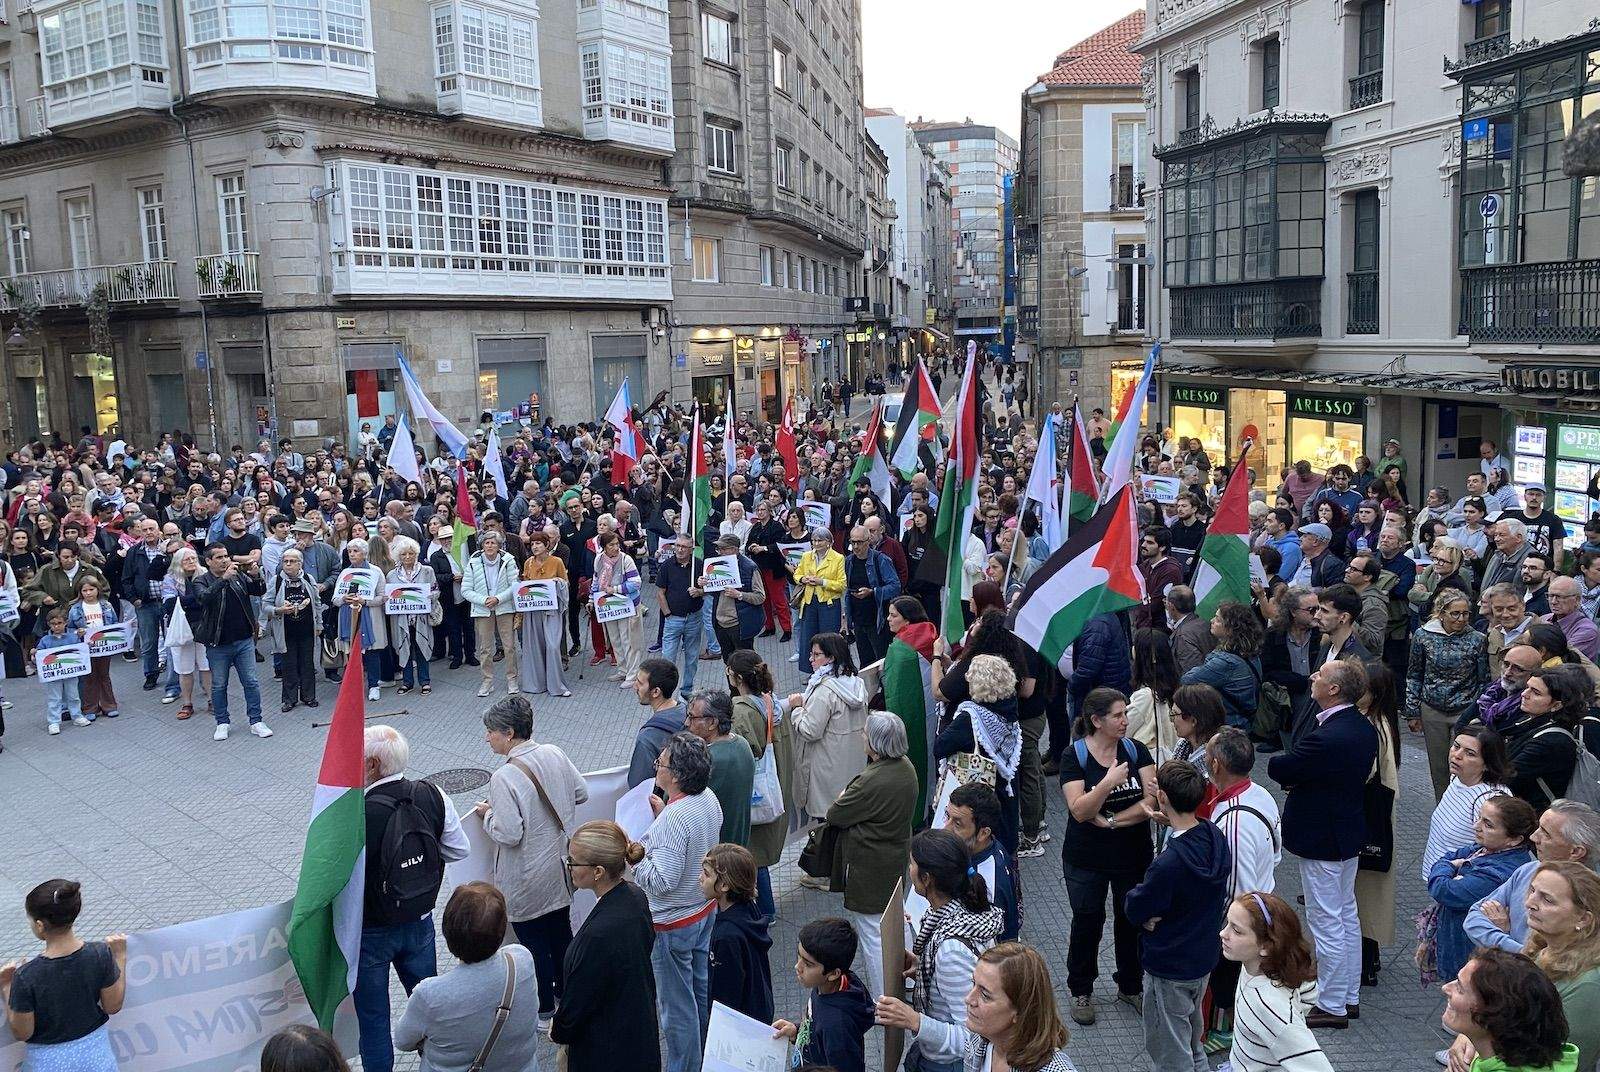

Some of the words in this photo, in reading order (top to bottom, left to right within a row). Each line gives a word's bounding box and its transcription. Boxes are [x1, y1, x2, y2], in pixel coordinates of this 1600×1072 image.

[1499, 368, 1600, 391] INMOBIL
[1175, 389, 1218, 403] ARESSO
[1293, 398, 1353, 415] ARESSO
[1576, 431, 1600, 446] PE
[607, 607, 631, 617] PALESTINA
[89, 646, 100, 654] CON
[101, 642, 128, 652] PALESTINA
[42, 663, 62, 671] GALIZA
[43, 671, 55, 679] CON
[56, 665, 87, 676] PALESTINA
